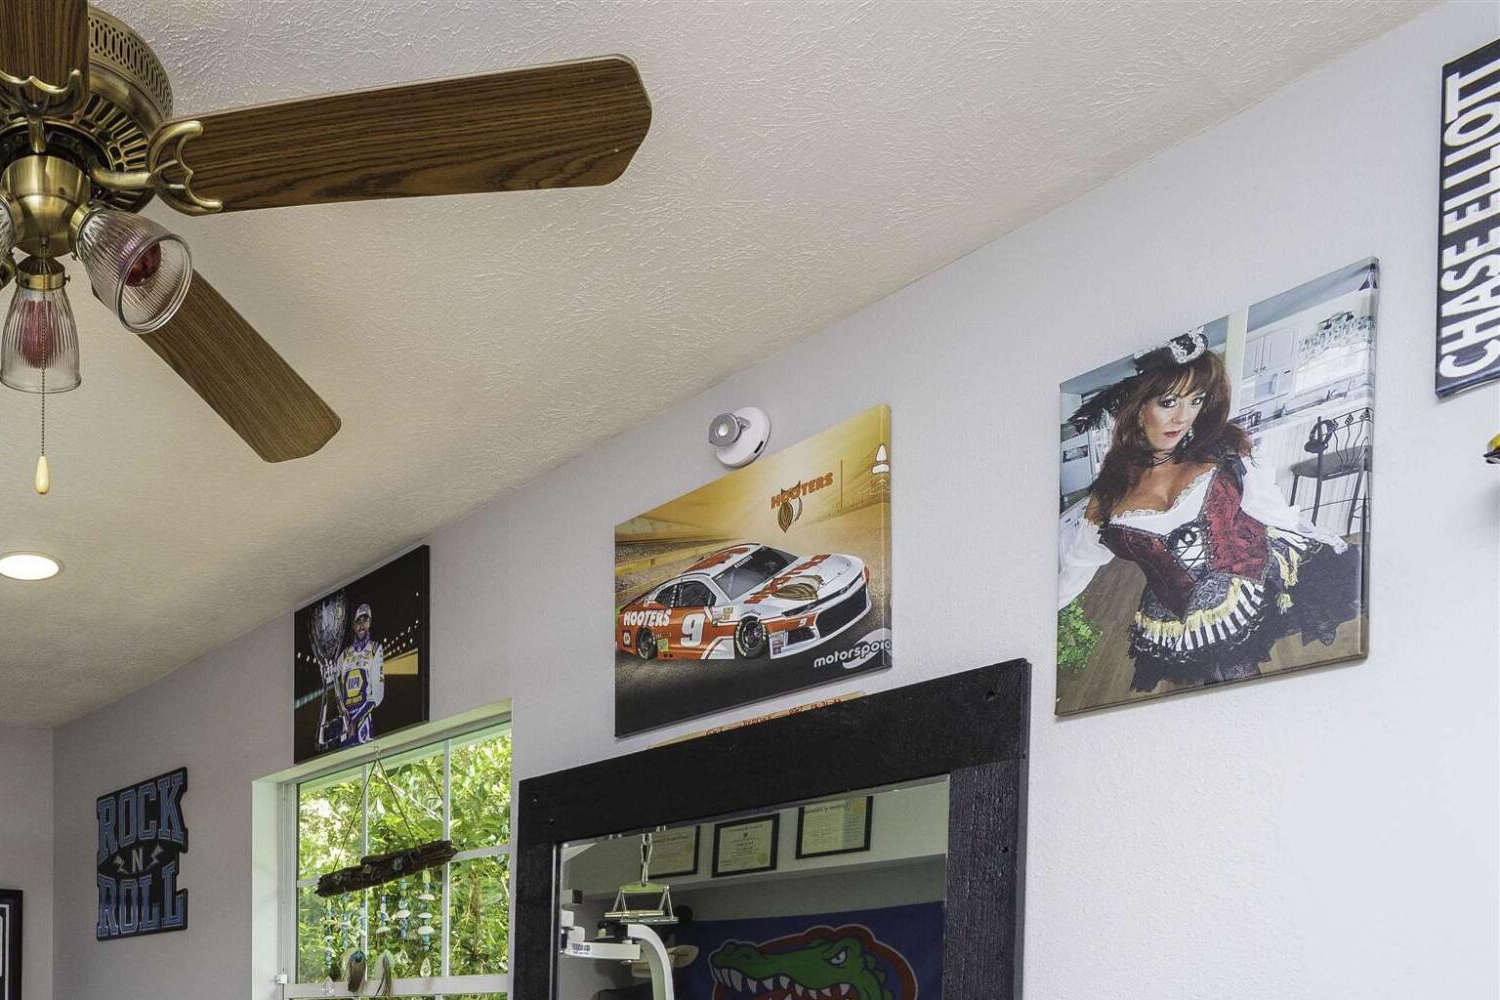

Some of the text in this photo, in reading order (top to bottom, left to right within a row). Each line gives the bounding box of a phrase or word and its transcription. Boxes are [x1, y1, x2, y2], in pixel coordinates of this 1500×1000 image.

[1439, 58, 1500, 378] CHASE ELLIOTT
[771, 472, 833, 509] HOOTERS
[623, 609, 671, 627] HOOTERS
[681, 612, 706, 648] 9
[98, 772, 184, 864] ROCK
[132, 848, 144, 874] N
[98, 861, 184, 937] ROLL
